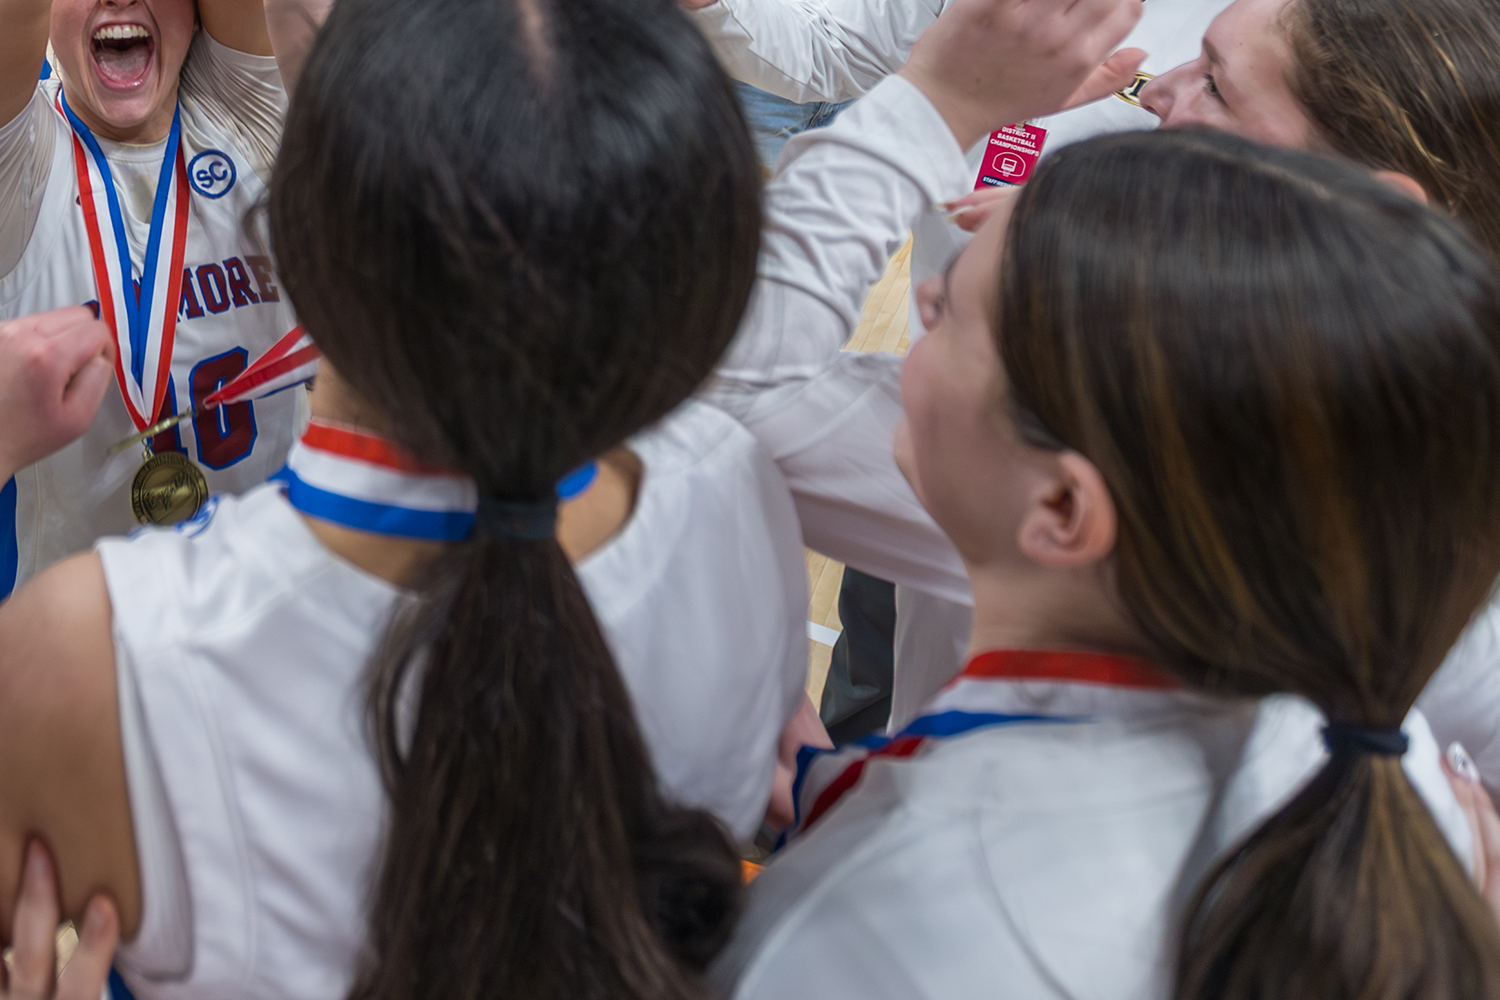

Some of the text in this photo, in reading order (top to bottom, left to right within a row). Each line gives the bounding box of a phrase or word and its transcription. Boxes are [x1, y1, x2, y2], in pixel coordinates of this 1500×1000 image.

[997, 132, 1036, 148] BASKETBALL
[1002, 126, 1031, 138] DISTRICT
[990, 138, 1040, 157] CHAMPIONSHIPS
[196, 160, 229, 190] SC
